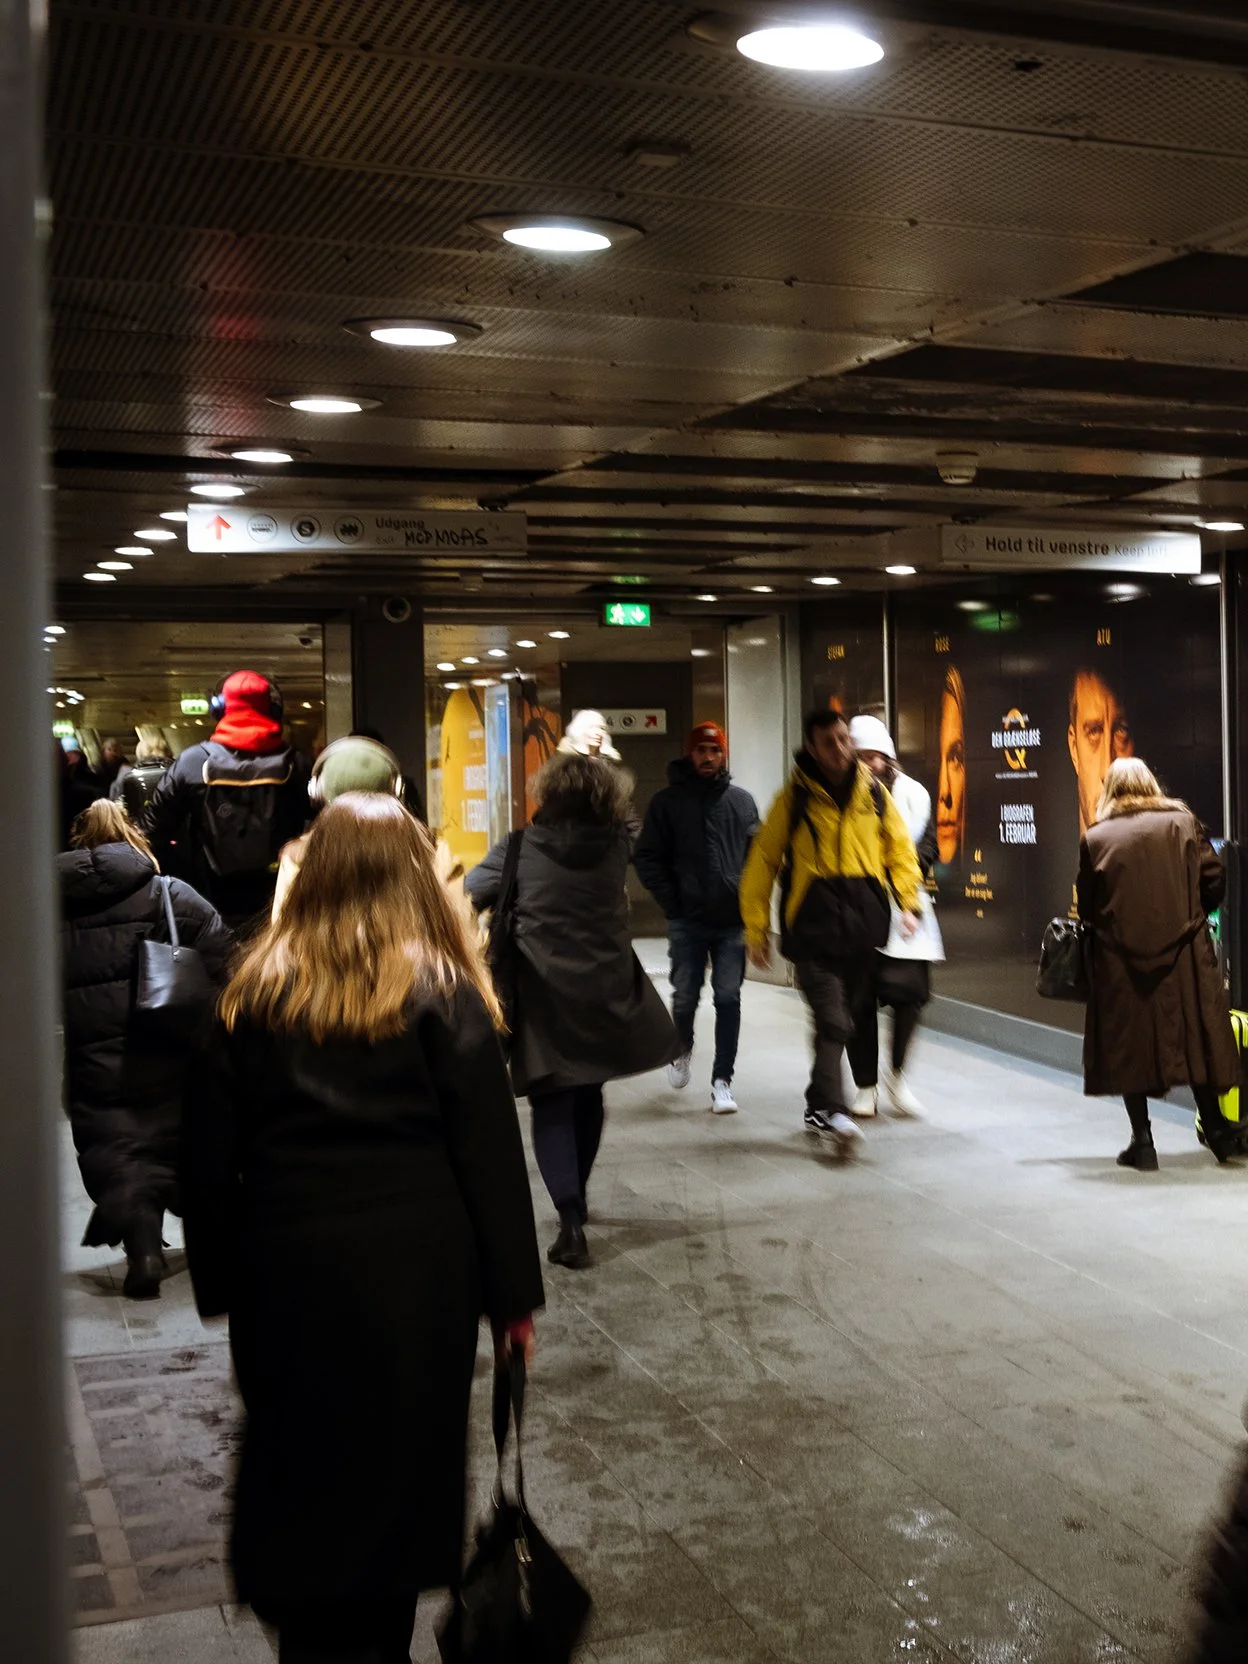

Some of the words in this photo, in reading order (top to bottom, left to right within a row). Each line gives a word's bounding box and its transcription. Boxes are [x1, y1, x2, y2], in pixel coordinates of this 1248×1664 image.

[375, 517, 425, 531] Udgang
[985, 536, 1022, 552] Hold
[1027, 537, 1044, 553] til
[1049, 540, 1109, 556] venstre
[1114, 543, 1144, 557] Keep
[991, 731, 1003, 749] DEN
[1005, 822, 1037, 844] FEBRUAR
